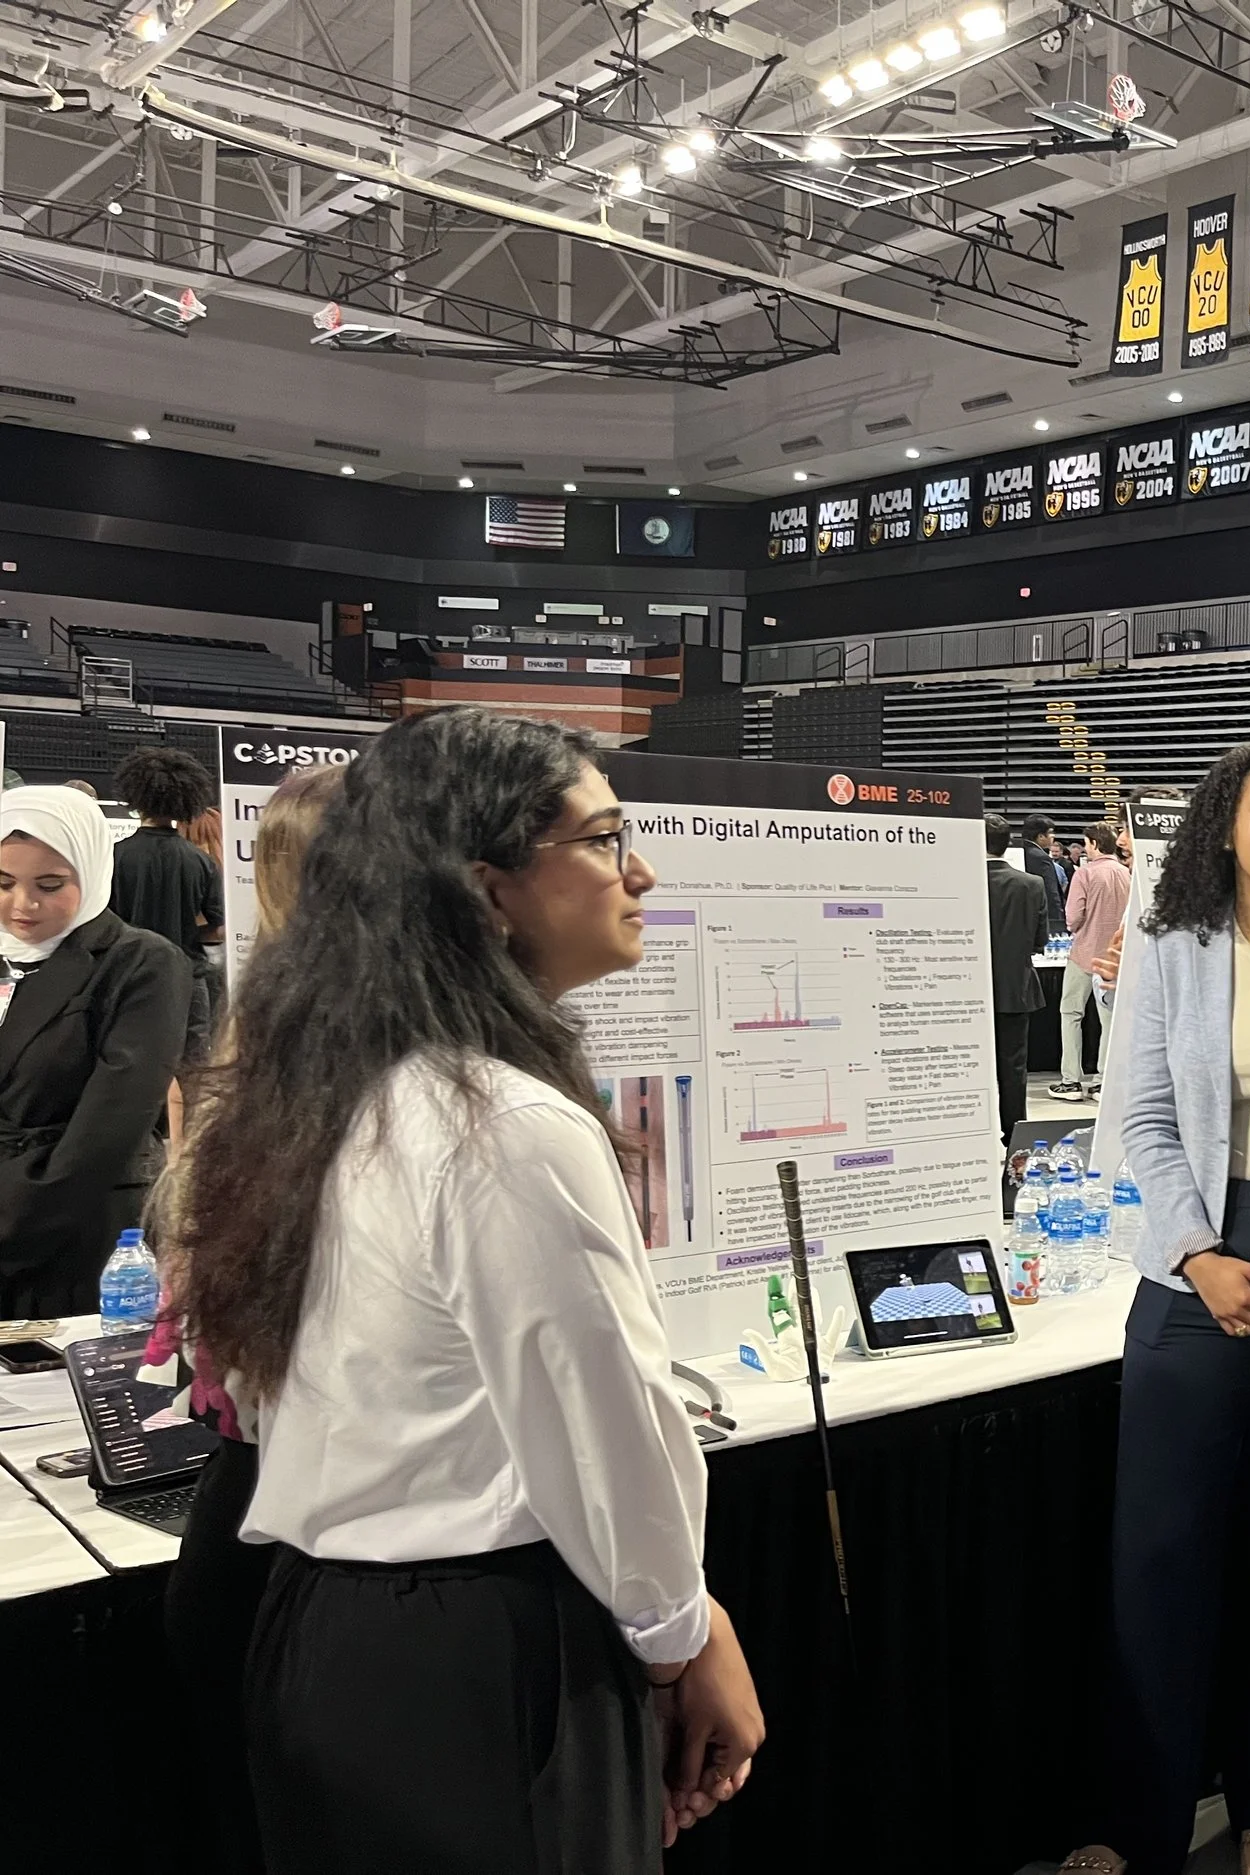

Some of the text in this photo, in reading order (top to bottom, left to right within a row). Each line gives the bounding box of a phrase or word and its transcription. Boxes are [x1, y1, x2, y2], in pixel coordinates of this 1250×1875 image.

[1194, 212, 1228, 238] HOOVER
[1194, 271, 1225, 295] VCU
[1127, 286, 1158, 308] VCU
[1198, 295, 1217, 317] 20
[1132, 308, 1150, 328] 00
[1115, 342, 1159, 364] 2005-2009
[1189, 332, 1226, 357] 1985-1989
[1189, 422, 1250, 460] NCAA
[1116, 439, 1175, 473] NCAA
[1047, 452, 1101, 485] NCAA
[985, 465, 1033, 496] NCAA
[1136, 477, 1174, 500] 2004
[869, 489, 912, 516] NCAA
[923, 477, 970, 507] NCAA
[1066, 488, 1100, 511] 1996
[770, 506, 808, 532] NCAA
[819, 499, 859, 525] NCAA
[940, 511, 968, 532] 1984
[1002, 501, 1032, 522] 1985
[832, 530, 854, 548] 1981
[884, 520, 910, 539] 1983
[470, 658, 499, 667] SCOTT
[858, 785, 950, 805] BME 25-102
[234, 798, 267, 820] Im
[638, 816, 684, 836] with
[692, 817, 759, 842] Digital
[766, 820, 879, 845] Amputation
[885, 827, 903, 844] of
[909, 827, 936, 845] the
[741, 884, 773, 892] Sponsor:
[837, 906, 869, 917] Results
[840, 1154, 888, 1167] Conclusion
[725, 1246, 815, 1267] Acknowledgets
